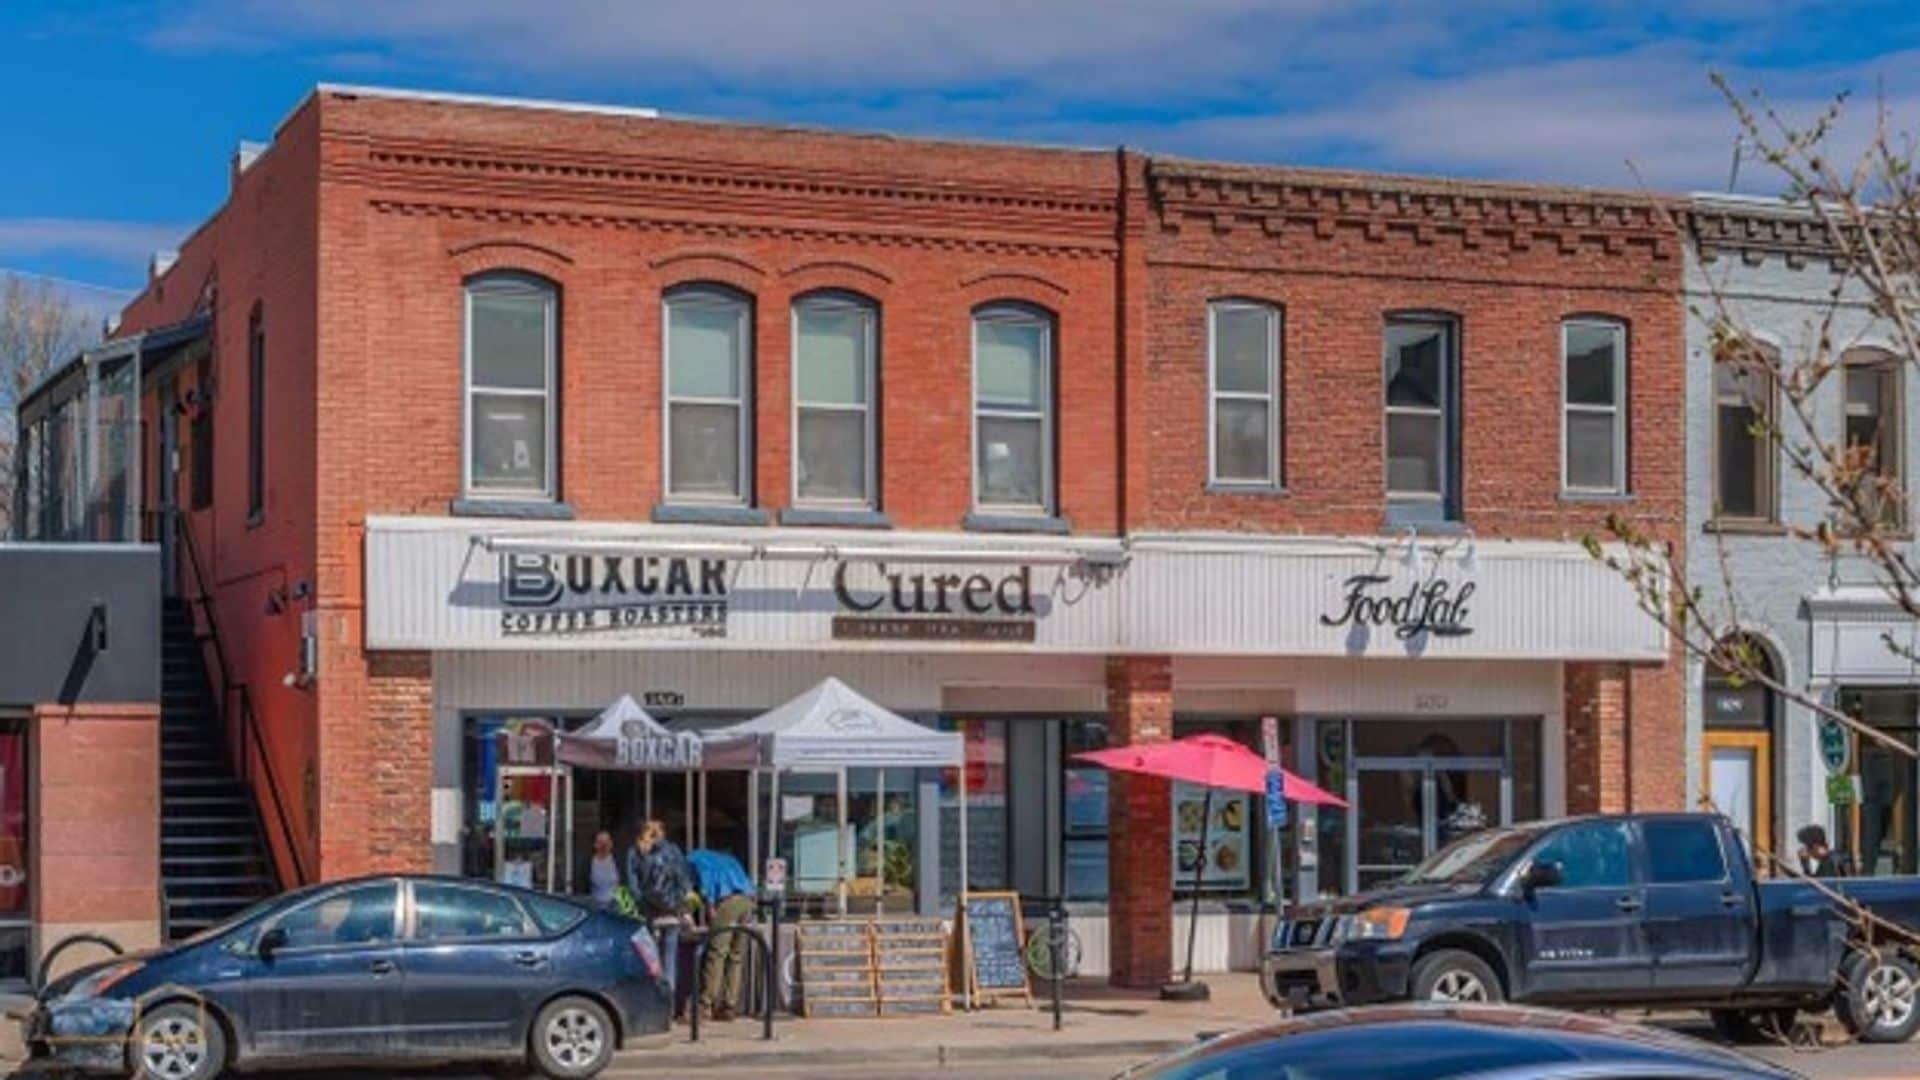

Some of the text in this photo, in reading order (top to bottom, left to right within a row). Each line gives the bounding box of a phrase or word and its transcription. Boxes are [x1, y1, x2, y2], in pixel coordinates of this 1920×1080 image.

[834, 560, 1035, 614] Cured
[501, 604, 727, 634] COFFEE ROASTERS
[616, 733, 704, 769] BOXCAR
